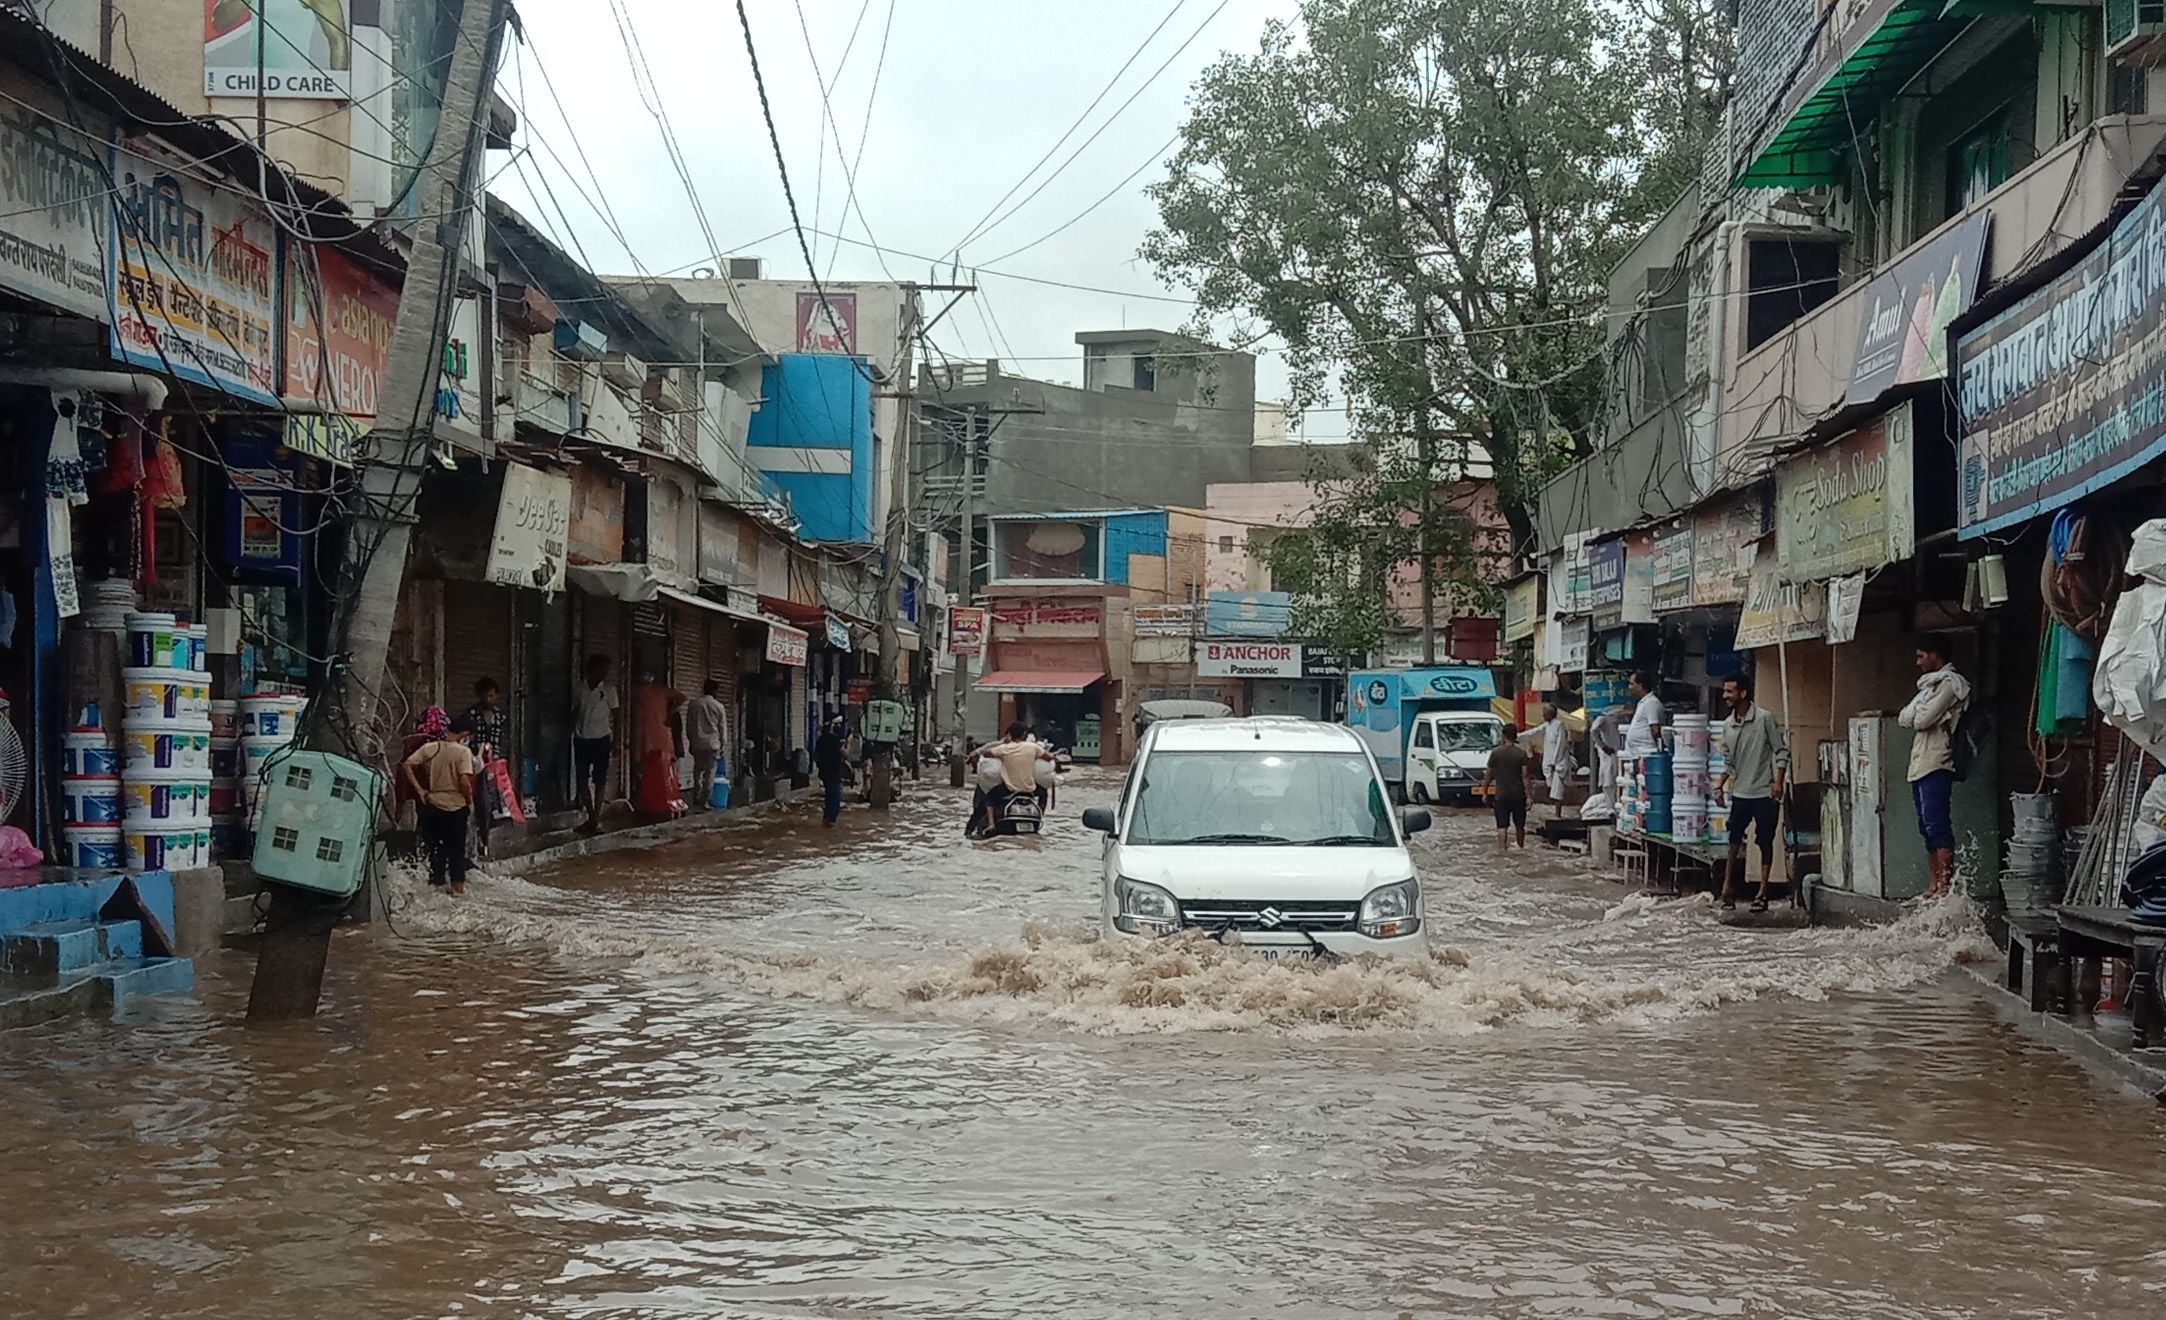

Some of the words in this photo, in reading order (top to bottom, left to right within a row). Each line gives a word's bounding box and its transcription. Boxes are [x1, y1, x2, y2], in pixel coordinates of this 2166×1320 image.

[286, 77, 334, 92] CARE
[1862, 284, 1907, 356] Amul
[1961, 353, 1992, 420] जय
[1993, 327, 2054, 410] भगवान
[1816, 461, 1848, 511] Soda
[1850, 450, 1886, 502] Shop
[1224, 646, 1291, 661] ANCHOR
[1230, 665, 1279, 675] Panasonic
